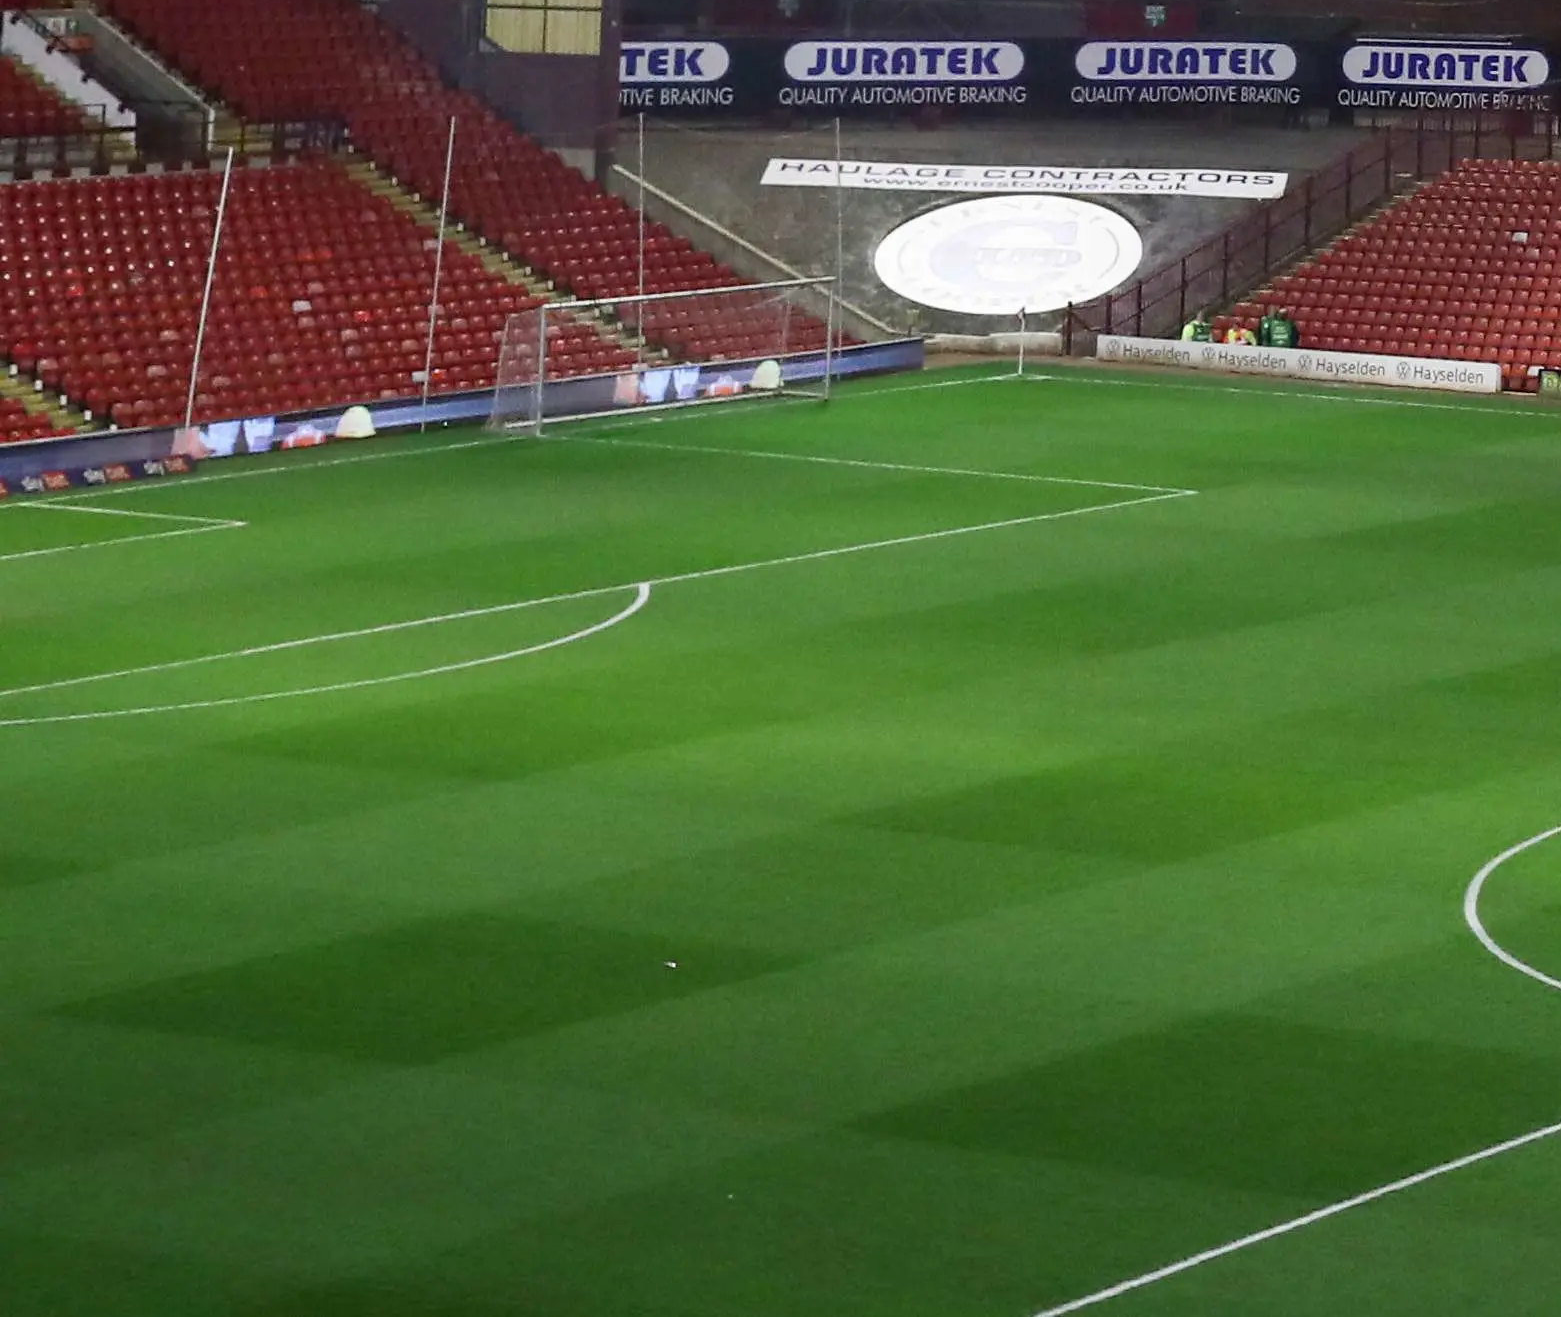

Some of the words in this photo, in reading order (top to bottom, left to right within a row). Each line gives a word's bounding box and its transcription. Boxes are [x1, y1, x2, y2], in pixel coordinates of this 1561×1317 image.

[620, 48, 705, 76] TEK
[807, 47, 1001, 76] JURATEK
[1097, 47, 1276, 76] JURATEK
[1362, 50, 1530, 82] JURATEK
[660, 88, 734, 106] BRAKING
[779, 87, 848, 106] QUALITY
[850, 87, 956, 104] AUTOMOTIVE
[959, 86, 1027, 104] BRAKING
[1071, 85, 1136, 104] QUALITY
[1139, 86, 1237, 103] AUTOMOTIVE
[1241, 87, 1300, 104] BRAKING
[1338, 88, 1396, 107] QUALITY
[1400, 90, 1489, 109] AUTOMOTIVE
[779, 161, 967, 179] HAULAGE
[983, 168, 1276, 186] CONTRACTORS
[1218, 351, 1287, 370] Hayselden
[1315, 358, 1385, 377] Hayselden
[1413, 365, 1484, 384] Hayselden
